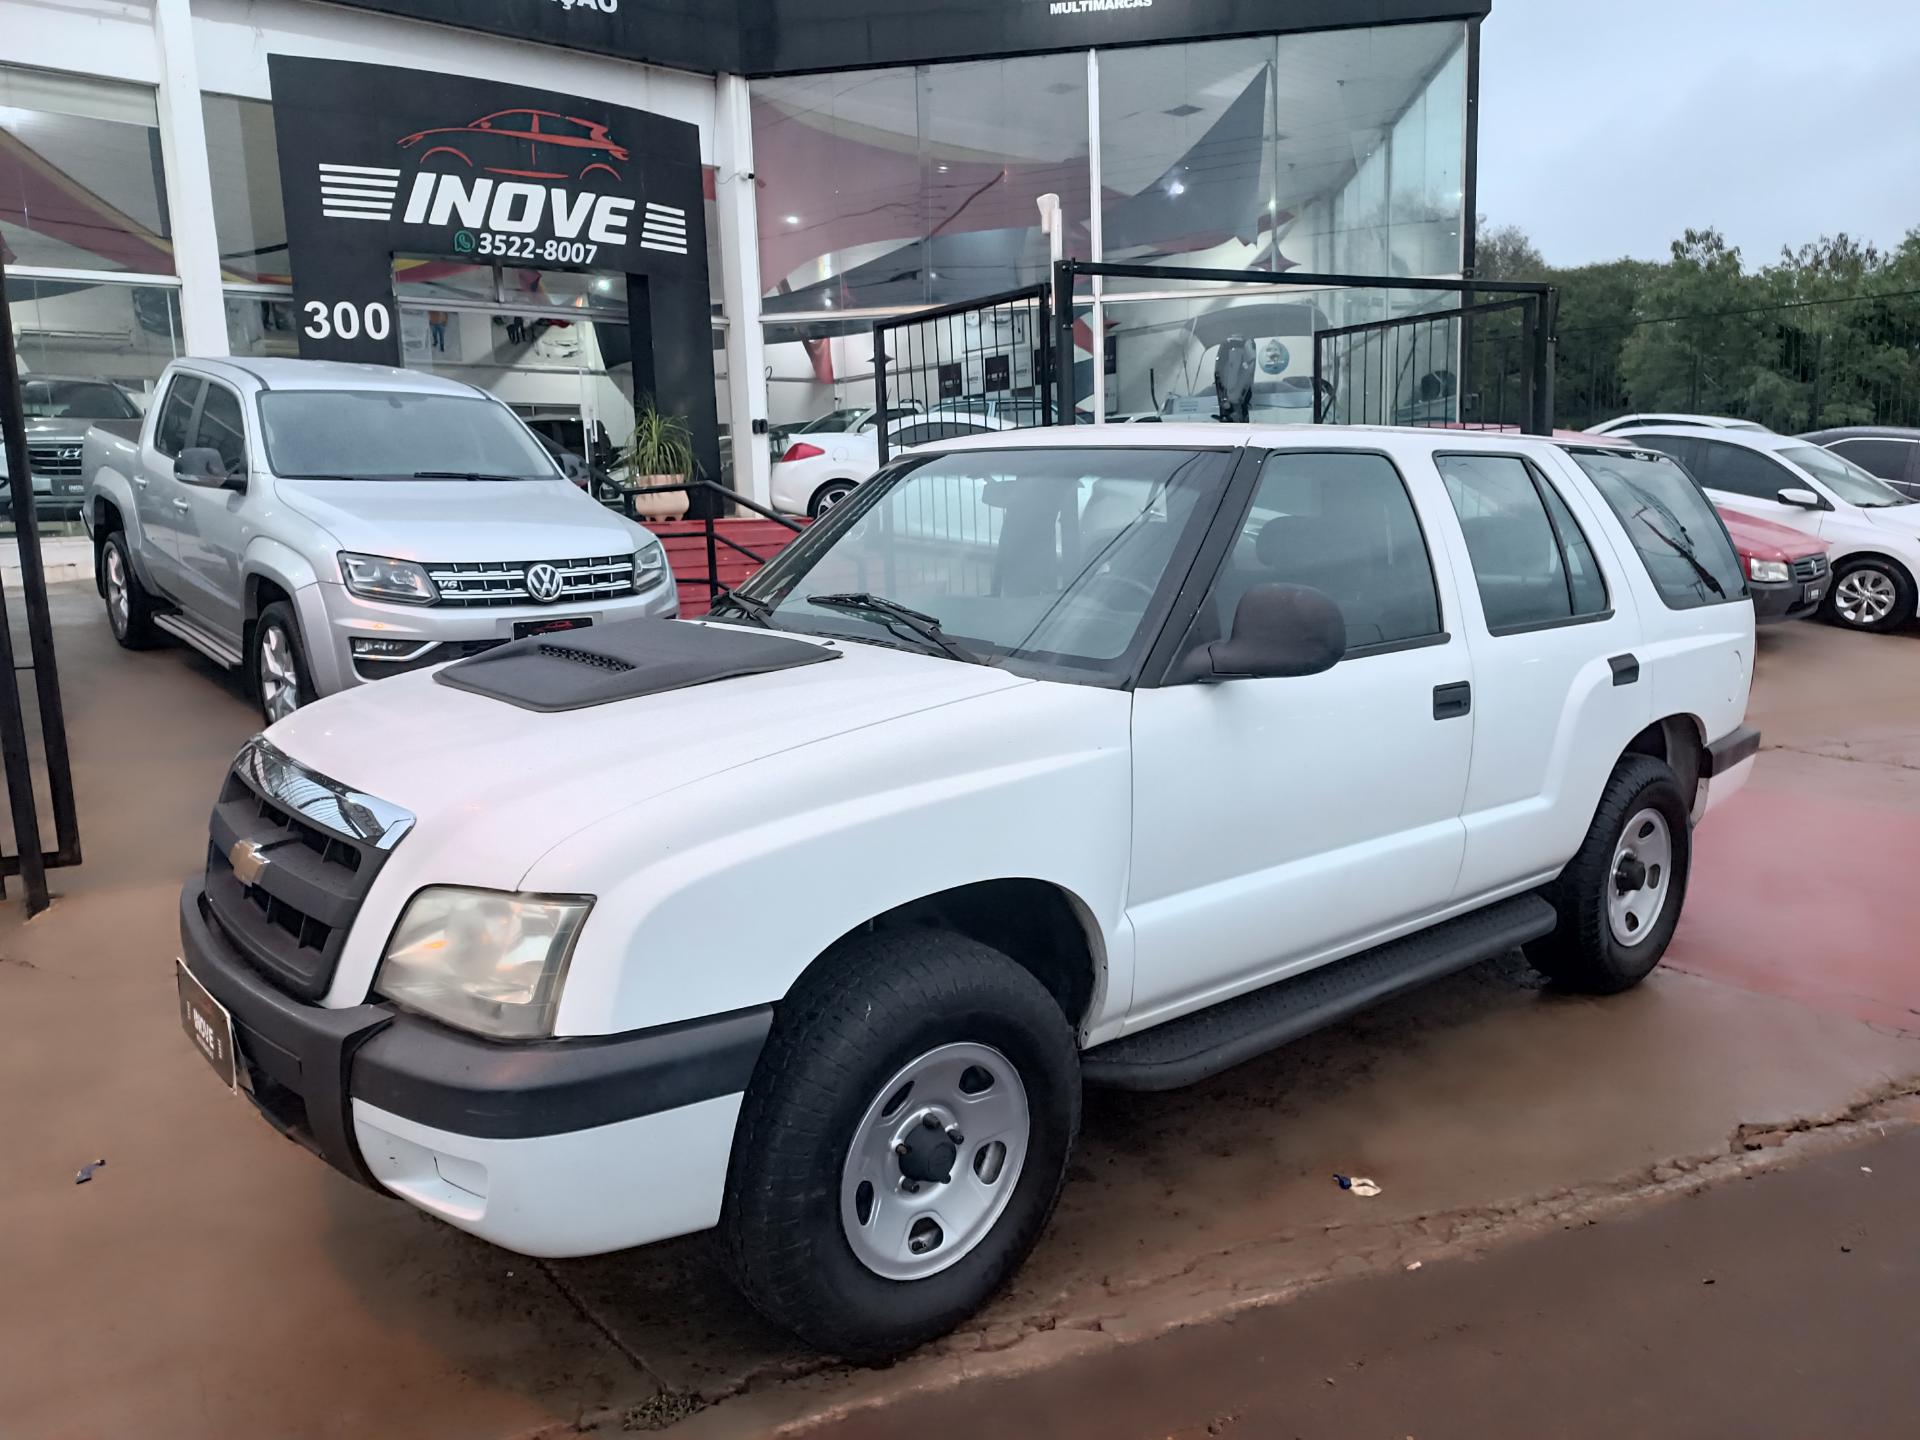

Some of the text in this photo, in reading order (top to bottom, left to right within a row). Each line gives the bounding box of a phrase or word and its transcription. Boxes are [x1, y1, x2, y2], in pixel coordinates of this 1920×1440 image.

[1049, 0, 1153, 14] MULTIMARCAS
[403, 171, 636, 246] INOVE
[477, 232, 598, 264] 3522-8007
[303, 300, 390, 340] 300
[438, 580, 458, 589] V6
